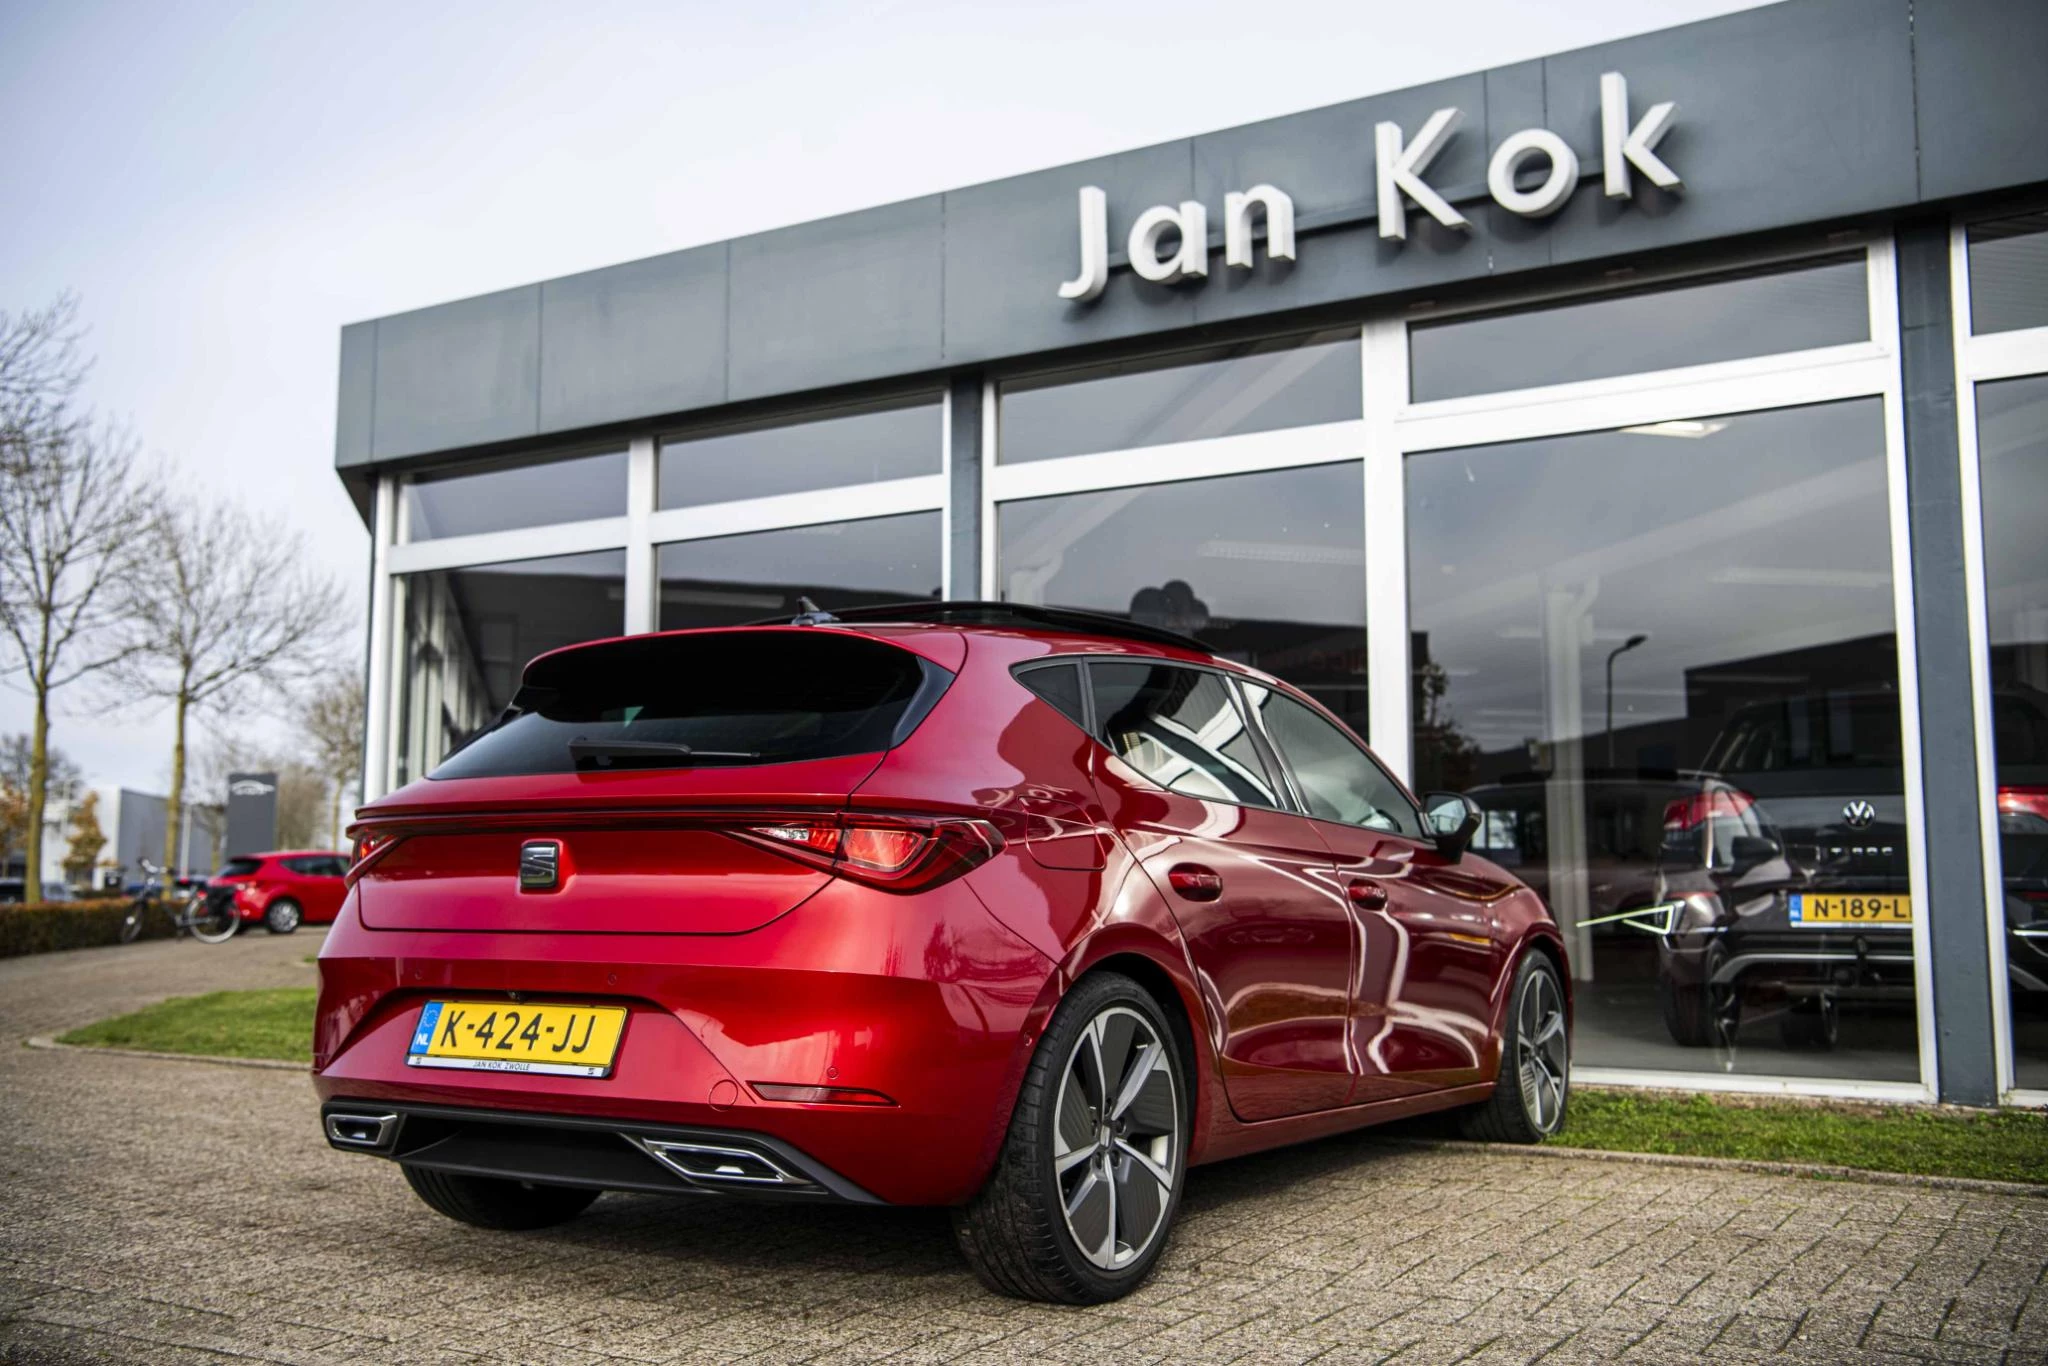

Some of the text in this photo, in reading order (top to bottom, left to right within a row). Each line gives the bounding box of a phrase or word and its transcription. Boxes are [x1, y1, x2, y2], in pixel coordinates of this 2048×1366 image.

[1057, 71, 1686, 300] Jan Kok
[1814, 898, 1912, 918] N-189-L
[415, 1033, 429, 1046] NL
[440, 1010, 597, 1053] K-424-JJ
[504, 1063, 530, 1071] ZWOLLE
